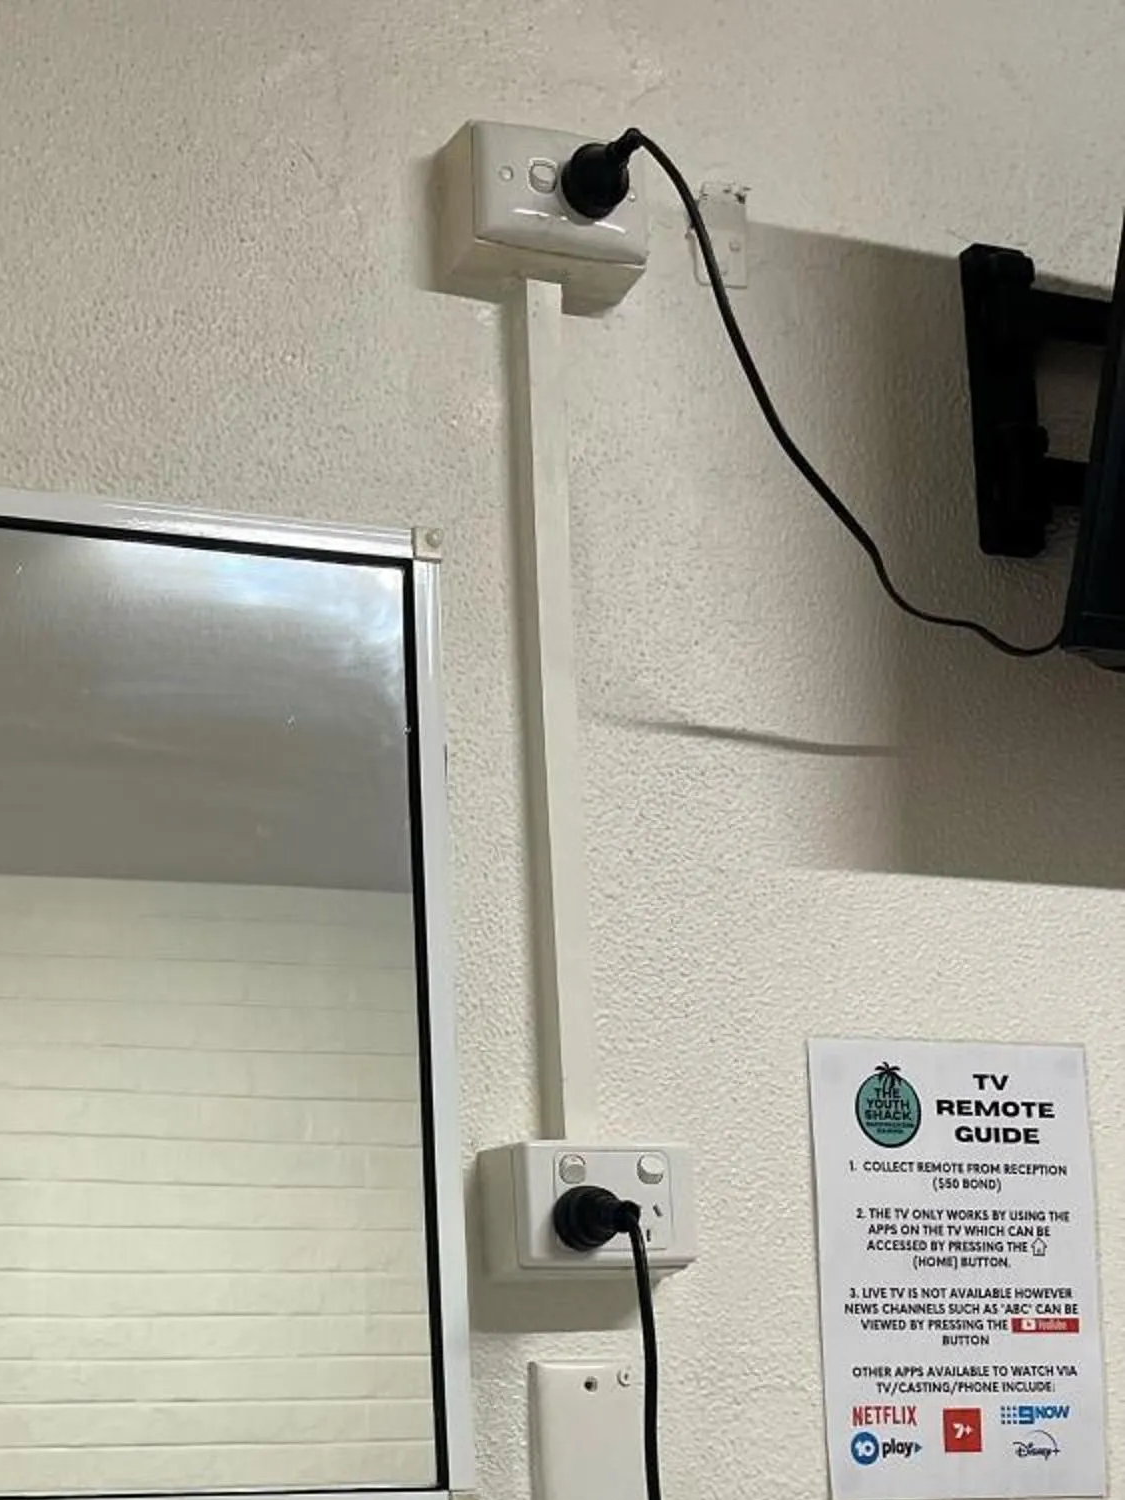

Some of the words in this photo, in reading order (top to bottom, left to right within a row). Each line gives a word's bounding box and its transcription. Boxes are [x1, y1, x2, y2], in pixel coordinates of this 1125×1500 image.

[973, 1074, 1008, 1091] TV
[874, 1088, 901, 1098] THE
[867, 1099, 909, 1109] YOUTH
[937, 1100, 1055, 1118] REMOTE
[865, 1110, 912, 1120] SHACK
[955, 1127, 1039, 1144] GUIDE
[850, 1161, 857, 1171] 1.
[863, 1161, 914, 1173] COLLECT
[917, 1162, 964, 1174] REMOTE
[967, 1163, 1000, 1174] FROM
[1004, 1164, 1067, 1175] RECEPTION
[963, 1179, 1002, 1193] BOND)
[856, 1209, 866, 1219] 2.
[869, 1208, 891, 1219] THE
[895, 1209, 909, 1220] TV
[913, 1209, 942, 1220] ONLY
[947, 1210, 988, 1221] WORKS
[992, 1210, 1006, 1221] BY
[1009, 1210, 1046, 1222] USING
[1049, 1211, 1070, 1222] THE
[868, 1224, 897, 1235] APPS
[901, 1225, 919, 1236] ON
[923, 1225, 944, 1236] THE
[948, 1226, 962, 1236] TV
[964, 1226, 1005, 1236] WHICH
[1008, 1226, 1033, 1237] CAN
[1036, 1226, 1050, 1237] BE
[867, 1240, 927, 1251] ACCESSED
[930, 1241, 945, 1251] BY
[949, 1241, 1003, 1252] PRESSING
[1007, 1242, 1028, 1253] THE
[913, 1255, 958, 1270] (HOME)
[961, 1257, 1010, 1268] BUTTON.
[850, 1288, 859, 1299] 3.
[863, 1288, 887, 1299] LIVE
[890, 1288, 905, 1299] TV
[908, 1288, 918, 1299] IS
[921, 1288, 946, 1299] NOT
[950, 1288, 1011, 1299] AVAILABLE
[1015, 1288, 1072, 1299] HOWEVER
[844, 1304, 877, 1314] NEWS
[882, 1304, 945, 1314] CHANNELS
[949, 1304, 980, 1314] SUCH
[983, 1304, 998, 1314] AS
[1035, 1304, 1061, 1314] CAN
[1064, 1304, 1078, 1314] BE
[861, 1320, 906, 1331] VIEWED
[910, 1320, 924, 1330] BY
[928, 1320, 984, 1331] PRESSING
[988, 1320, 1007, 1331] THE
[942, 1335, 989, 1346] BUTTON
[852, 1366, 891, 1378] OTHER
[895, 1366, 923, 1378] APPS
[927, 1366, 989, 1377] AVAILABLE
[992, 1366, 1007, 1377] TO
[1011, 1366, 1053, 1377] WATCH
[1057, 1366, 1077, 1377] VIA
[1002, 1381, 1055, 1393] INCLUDE:
[852, 1406, 917, 1426] NETFLIX
[882, 1438, 913, 1459] play
